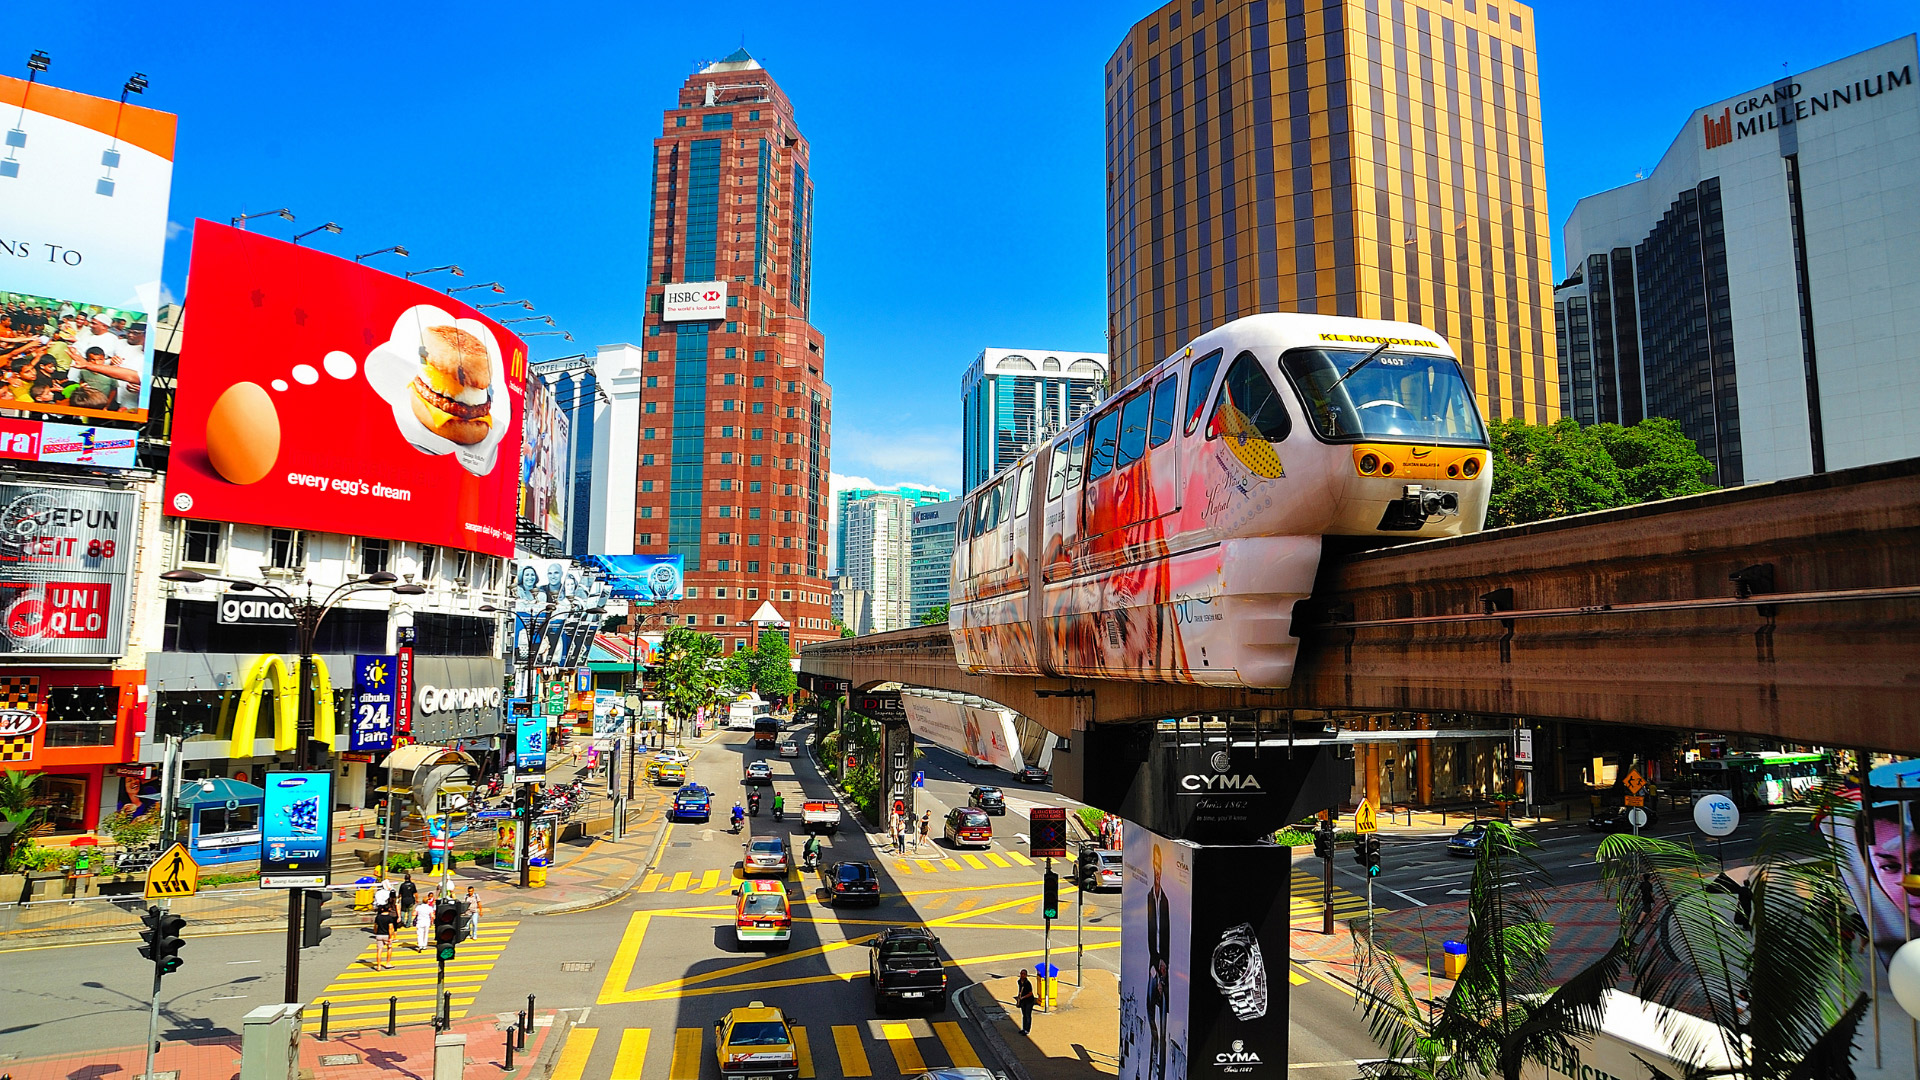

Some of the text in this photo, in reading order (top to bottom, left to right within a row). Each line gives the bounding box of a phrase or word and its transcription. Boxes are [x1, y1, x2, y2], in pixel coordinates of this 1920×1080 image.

[1734, 83, 1801, 115] GRAND
[1737, 65, 1912, 140] MILLENNIUM
[44, 243, 82, 266] TO
[668, 291, 700, 303] HSBC
[1321, 333, 1439, 349] KL MONORAIL
[534, 364, 559, 372] HOTEL
[1381, 357, 1404, 366] 0407
[287, 472, 411, 501] every egg's dream
[35, 507, 119, 529] JEPUN
[87, 539, 116, 558] 88
[52, 589, 99, 609] UNI
[50, 612, 102, 635] QLO
[359, 693, 391, 703] dibuka
[419, 685, 501, 714] GIORDANO
[358, 704, 390, 730] 24
[358, 731, 389, 746] jam
[894, 743, 904, 815] DIESEL
[1181, 774, 1261, 790] CYMA
[1225, 801, 1248, 809] 1862
[1710, 802, 1730, 813] yes
[1176, 860, 1190, 871] CYMA
[1216, 1052, 1261, 1062] CYMA
